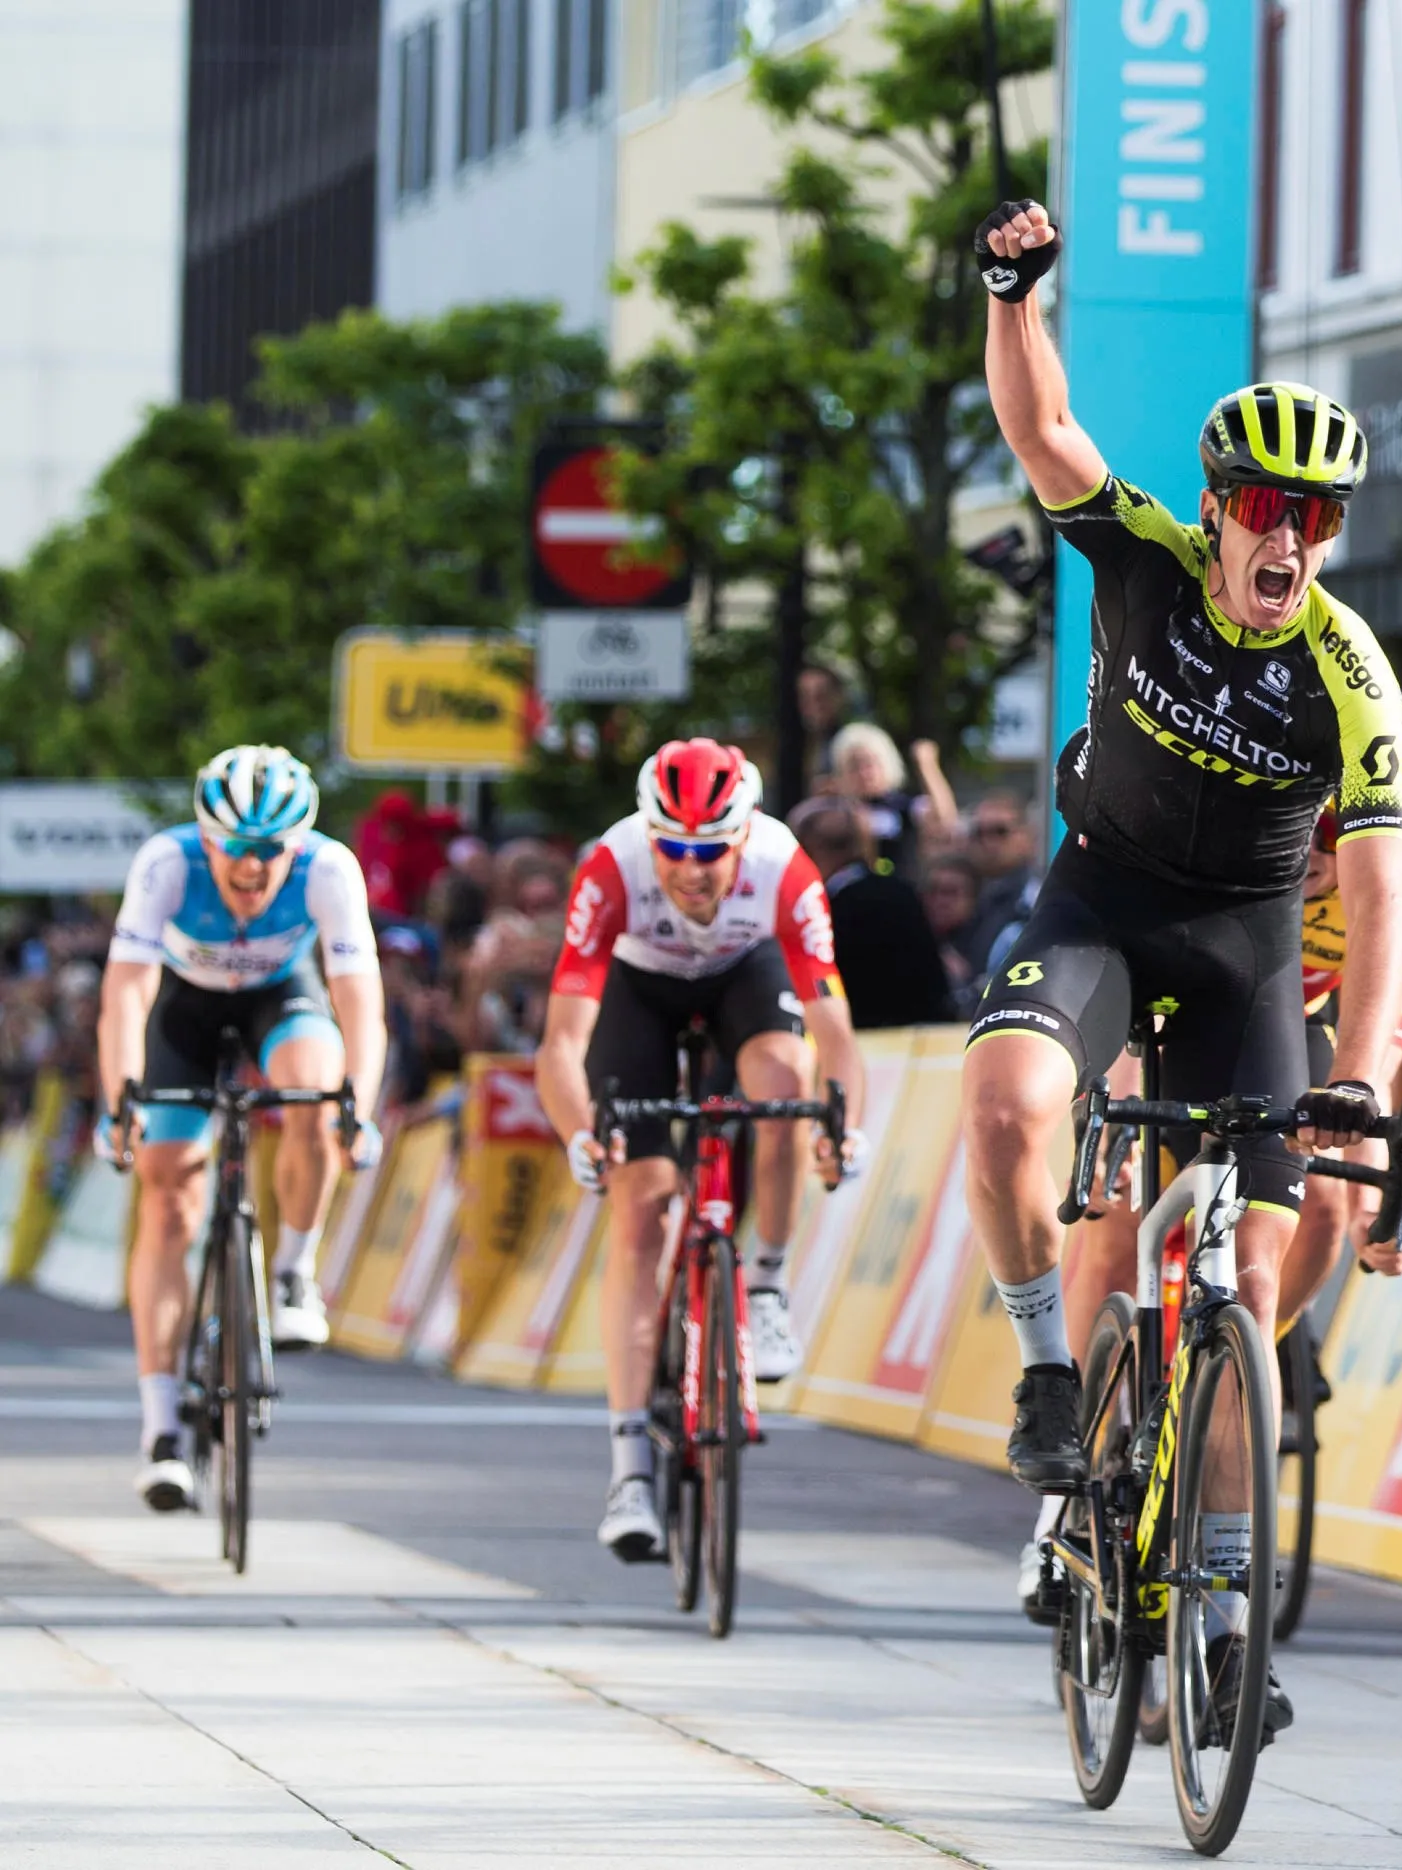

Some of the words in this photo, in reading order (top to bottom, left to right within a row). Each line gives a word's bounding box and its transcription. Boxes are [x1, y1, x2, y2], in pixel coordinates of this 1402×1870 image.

[1168, 637, 1213, 675] Jayco
[1318, 615, 1384, 701] letsgo
[1121, 698, 1305, 791] SCOTT
[1126, 654, 1312, 775] MITCHELTON
[966, 1009, 1061, 1045] ordana
